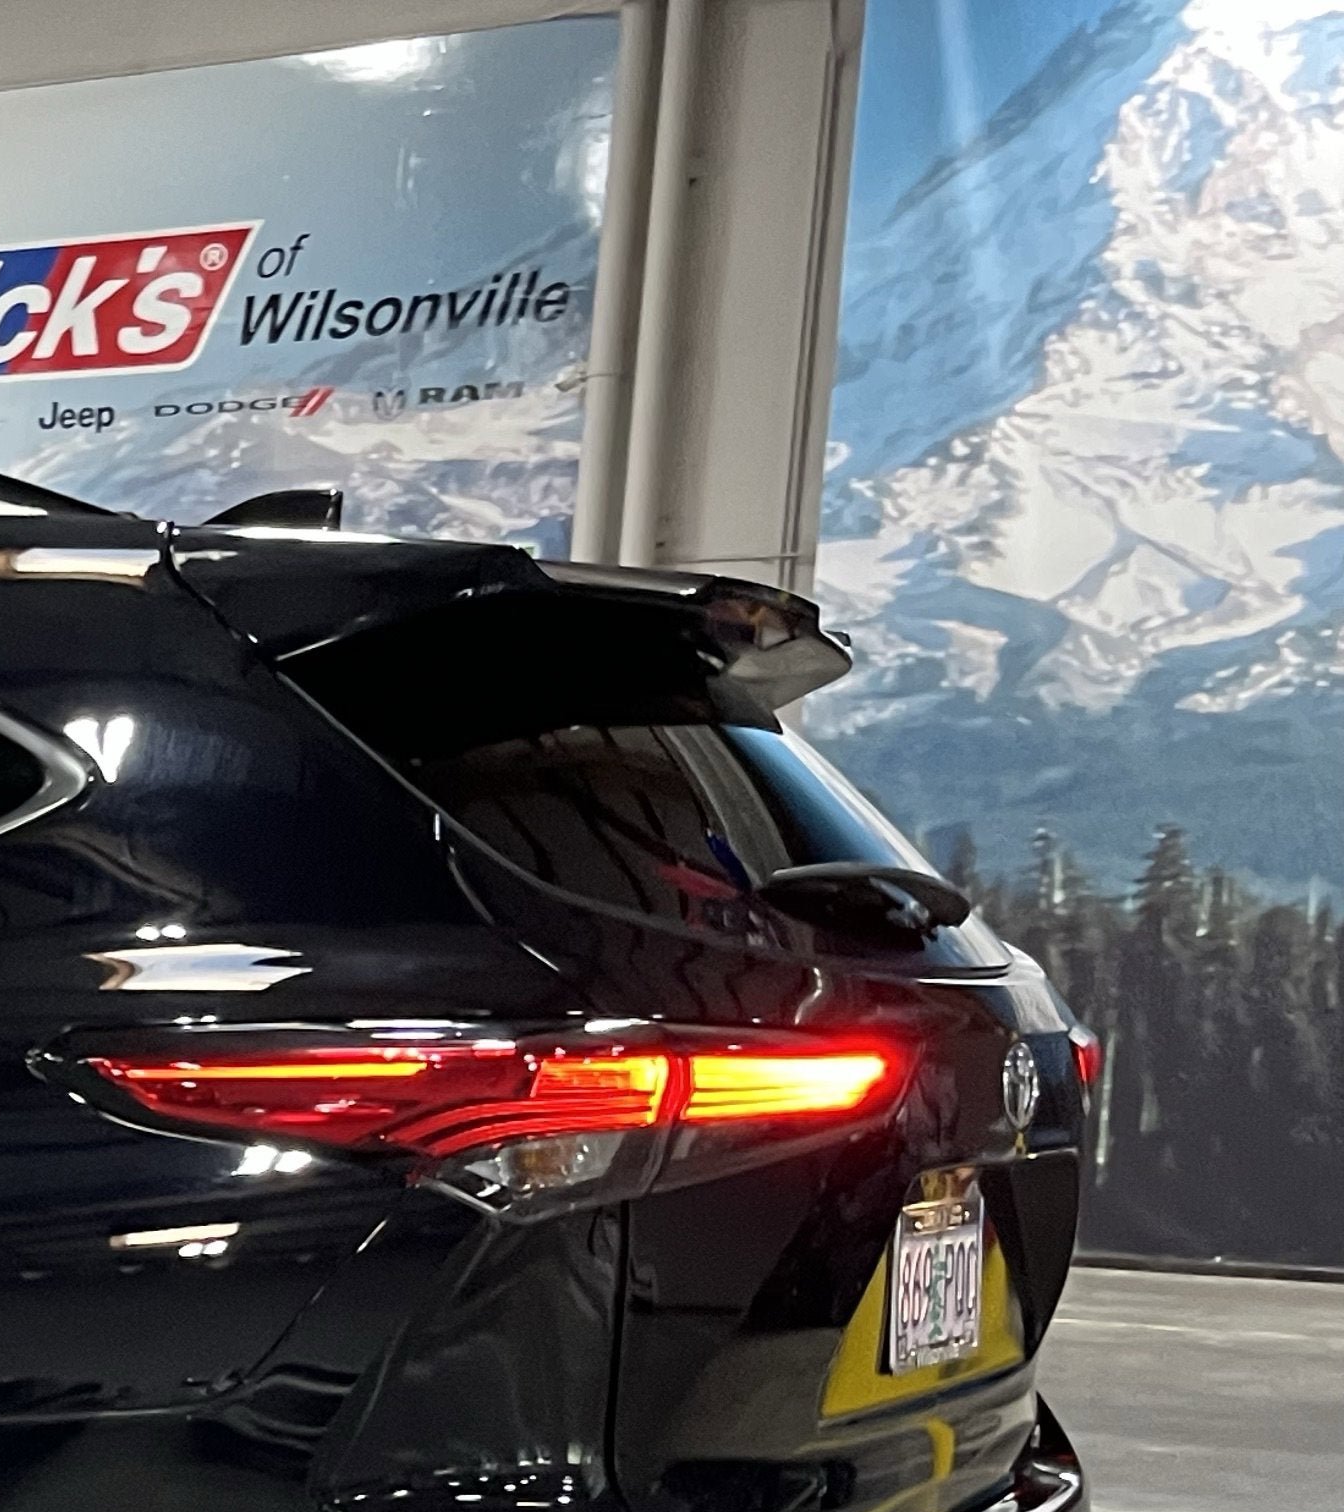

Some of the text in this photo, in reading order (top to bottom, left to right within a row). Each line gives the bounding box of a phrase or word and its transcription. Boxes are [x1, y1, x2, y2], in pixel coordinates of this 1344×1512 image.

[257, 233, 311, 279] of
[239, 268, 570, 346] Wilsonville
[154, 395, 309, 418] DODGE
[418, 381, 526, 405] RAM
[38, 402, 115, 433] Jeep
